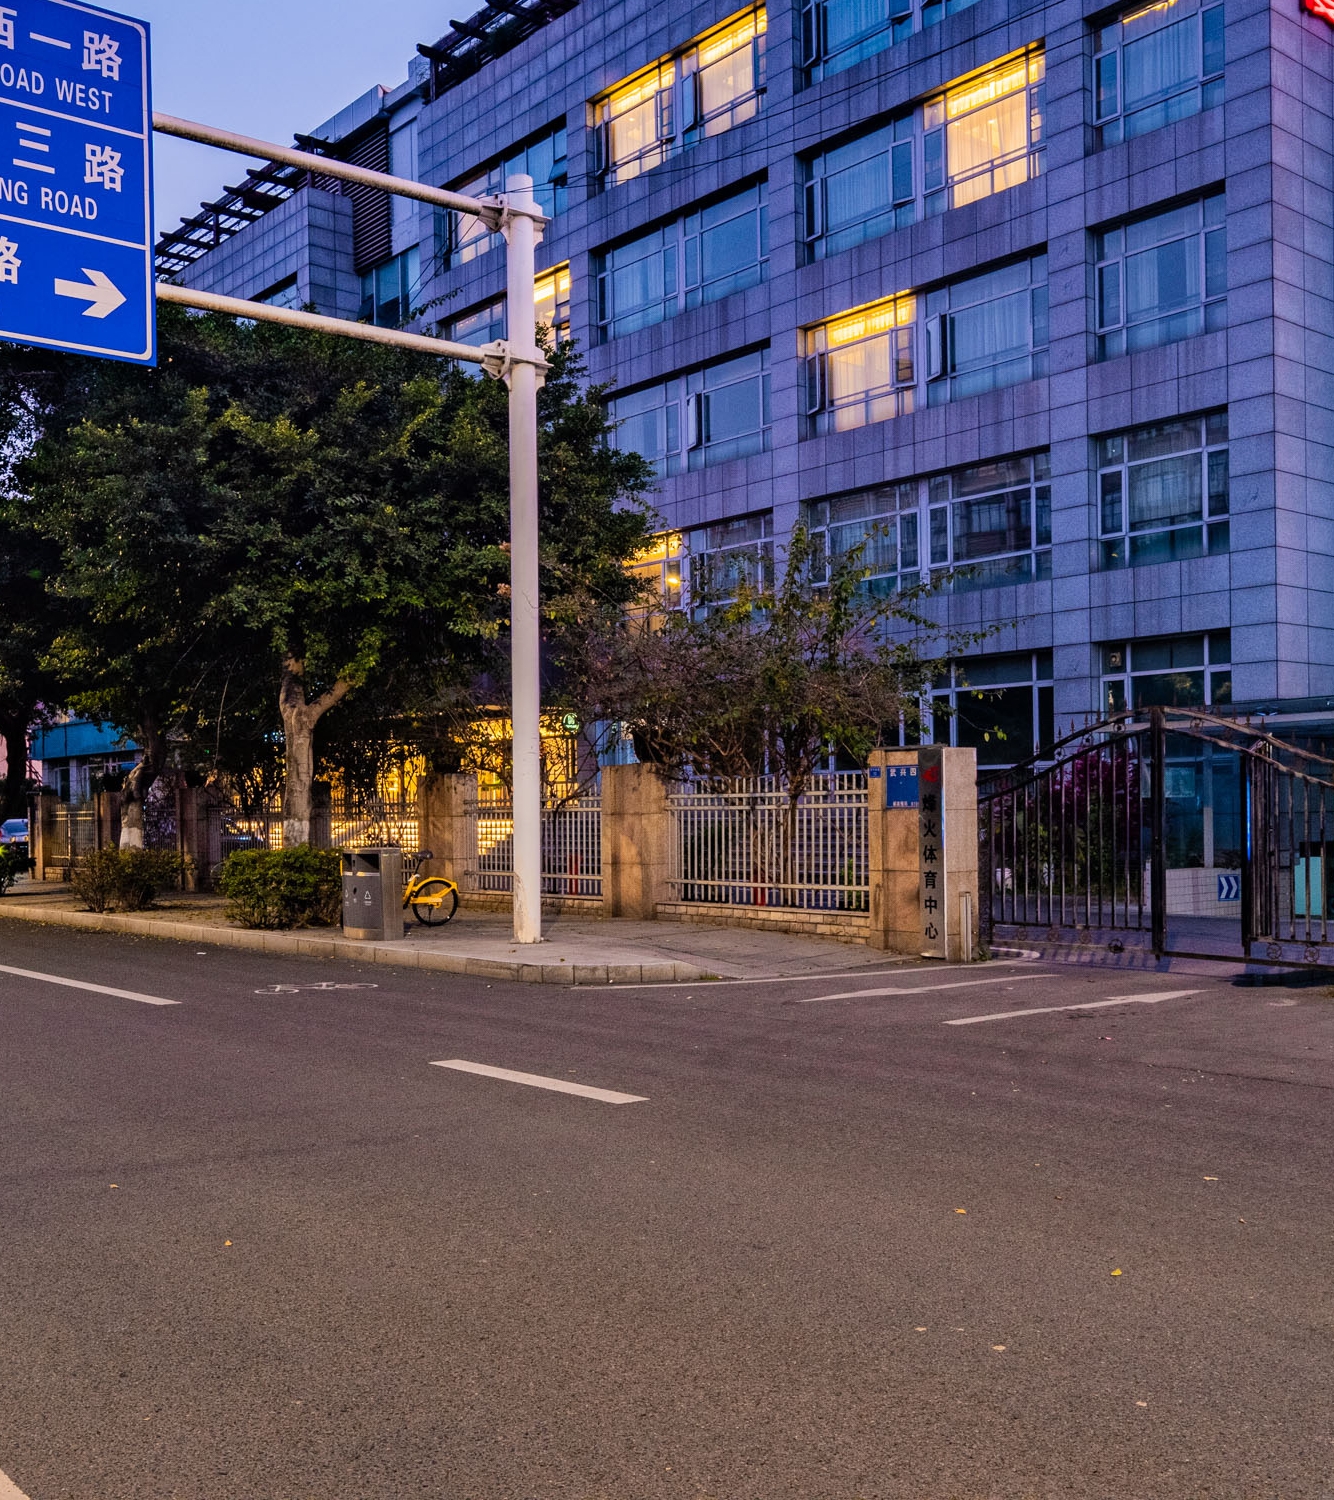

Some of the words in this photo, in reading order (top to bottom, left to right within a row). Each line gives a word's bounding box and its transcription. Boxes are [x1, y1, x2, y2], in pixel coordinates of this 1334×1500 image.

[55, 77, 113, 114] WEST
[40, 187, 98, 221] ROAD
[922, 793, 938, 940] 烽火体育中心
